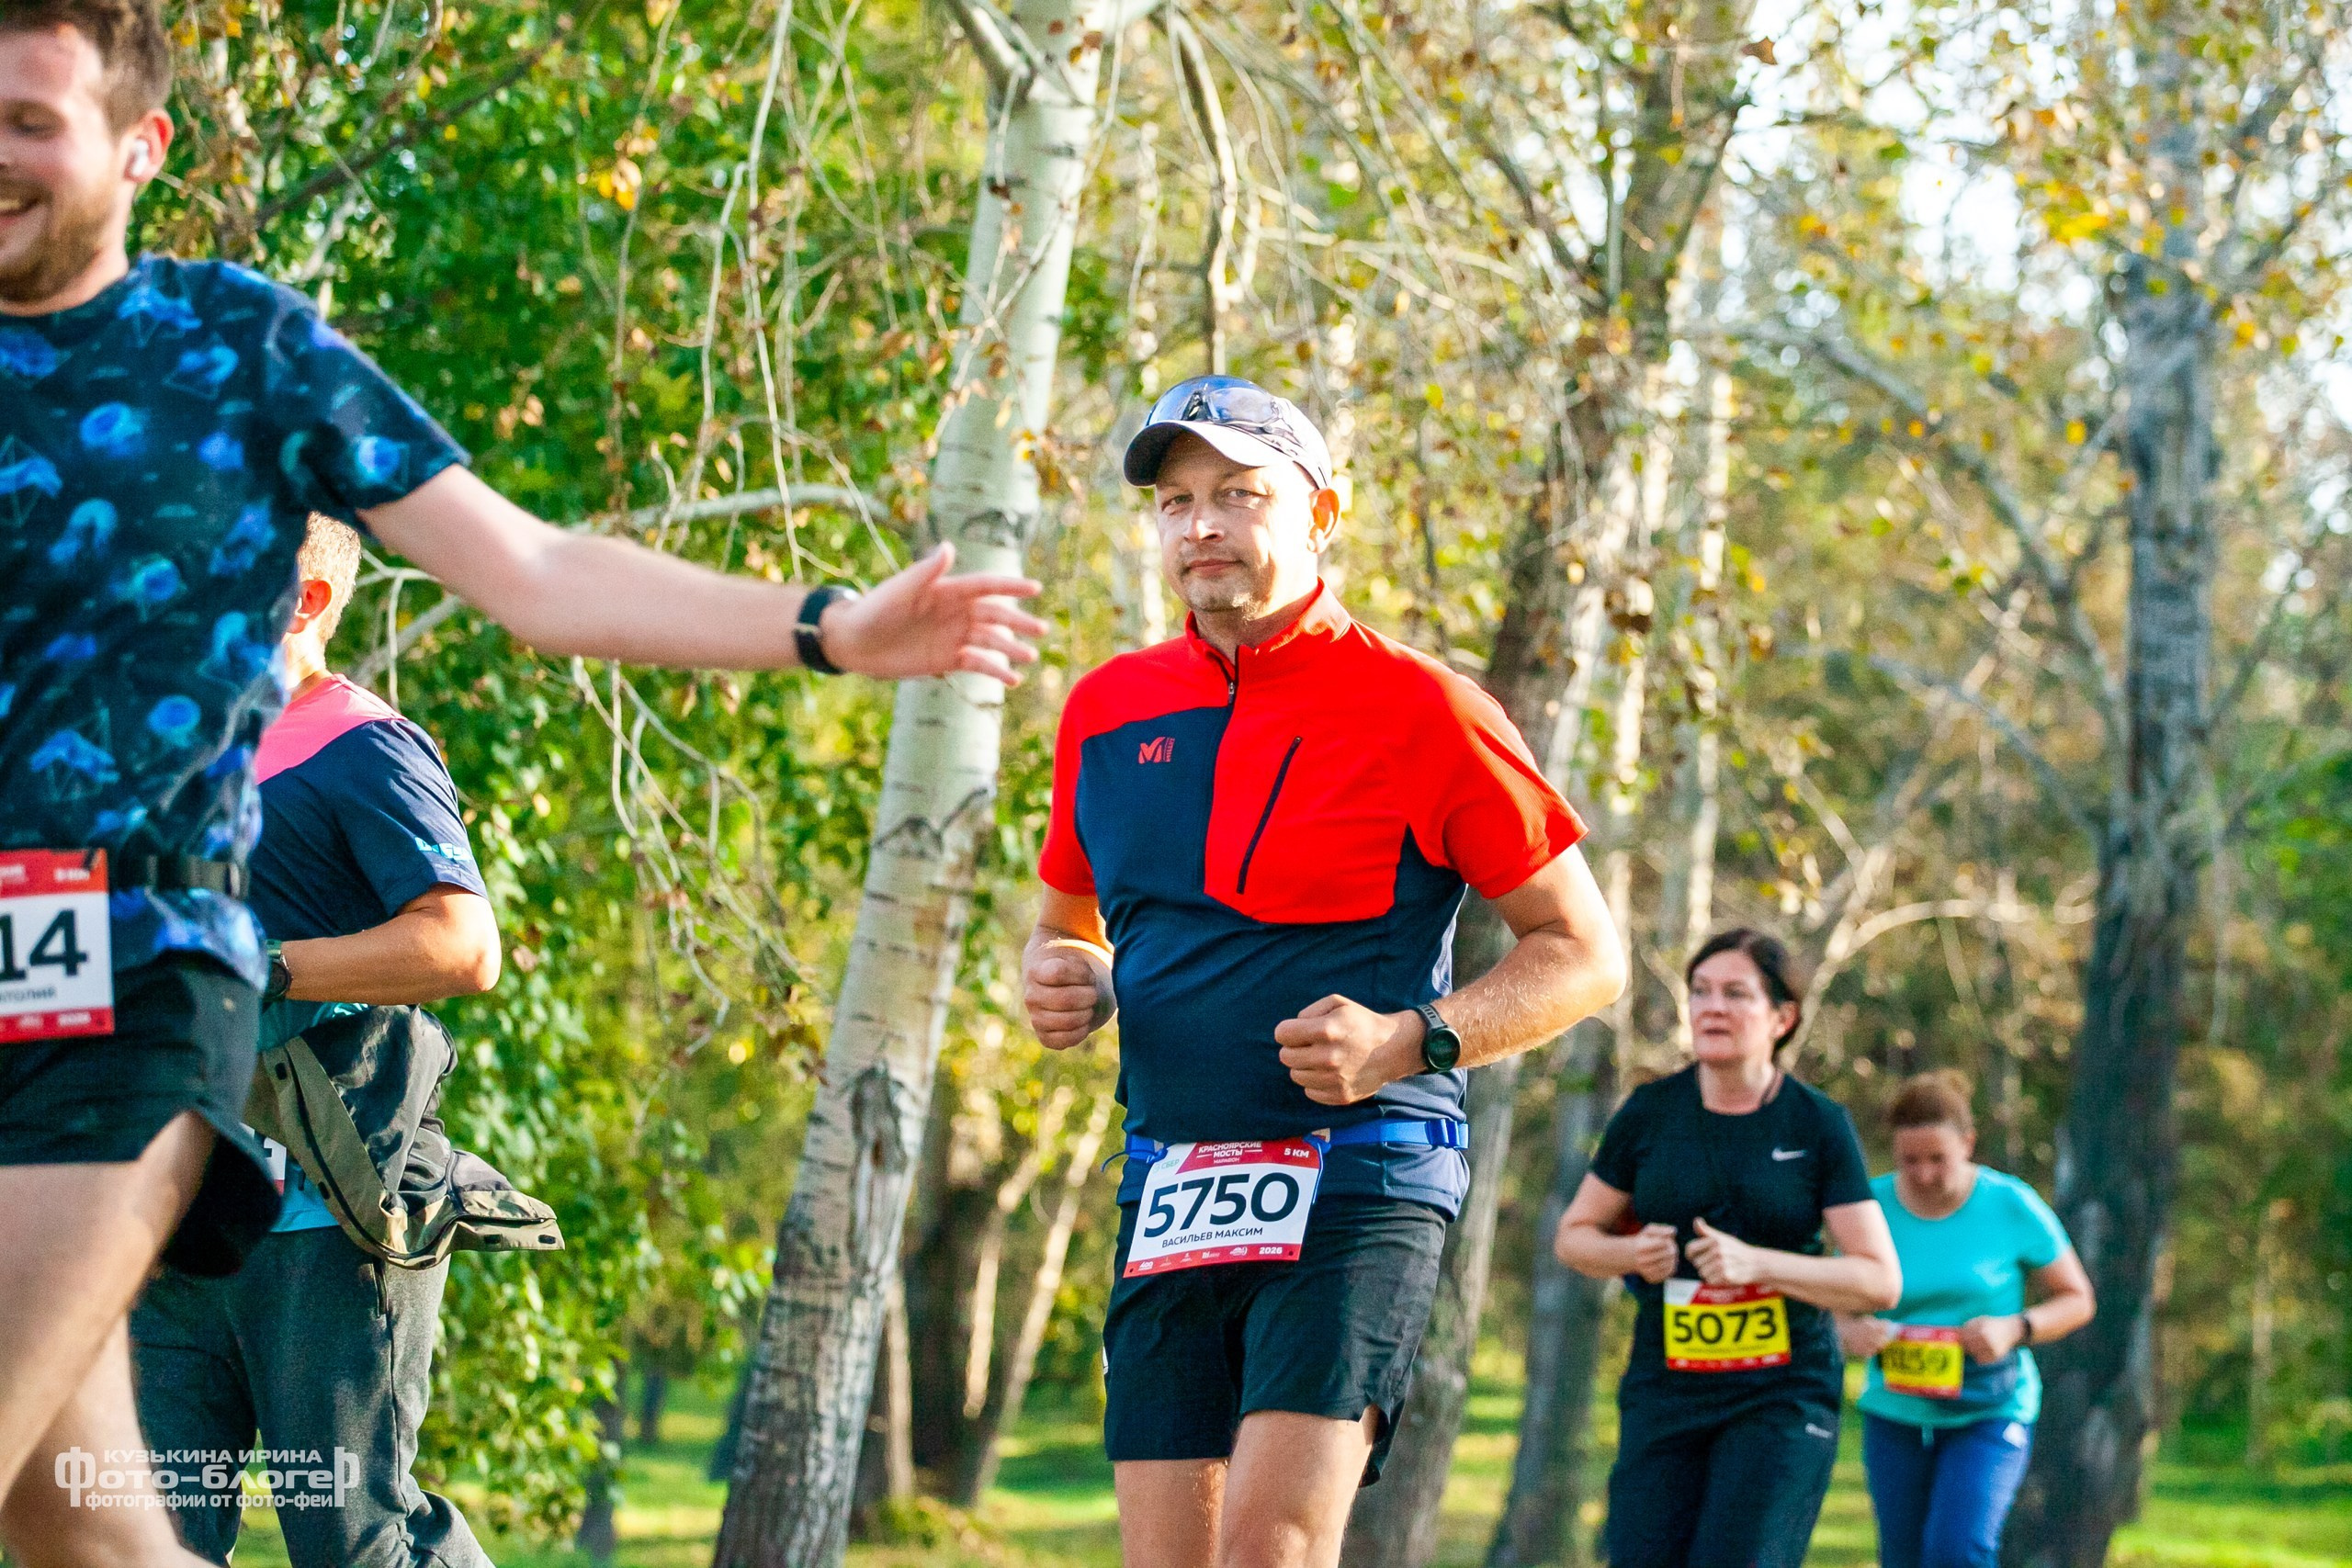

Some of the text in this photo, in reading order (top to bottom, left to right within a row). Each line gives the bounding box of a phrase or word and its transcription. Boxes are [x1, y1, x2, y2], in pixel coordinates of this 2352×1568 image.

[1198, 1142, 1262, 1154] КРАСНОЯРСКИЕ
[1213, 1149, 1243, 1157] МОСТЫ
[1283, 1147, 1309, 1157] 5 КМ
[1143, 1172, 1300, 1238] 5750
[1162, 1227, 1263, 1247] ВАСИЛЬЕВ МАКСИМ
[1259, 1247, 1283, 1255] 2026
[1673, 1306, 1777, 1344] 5073
